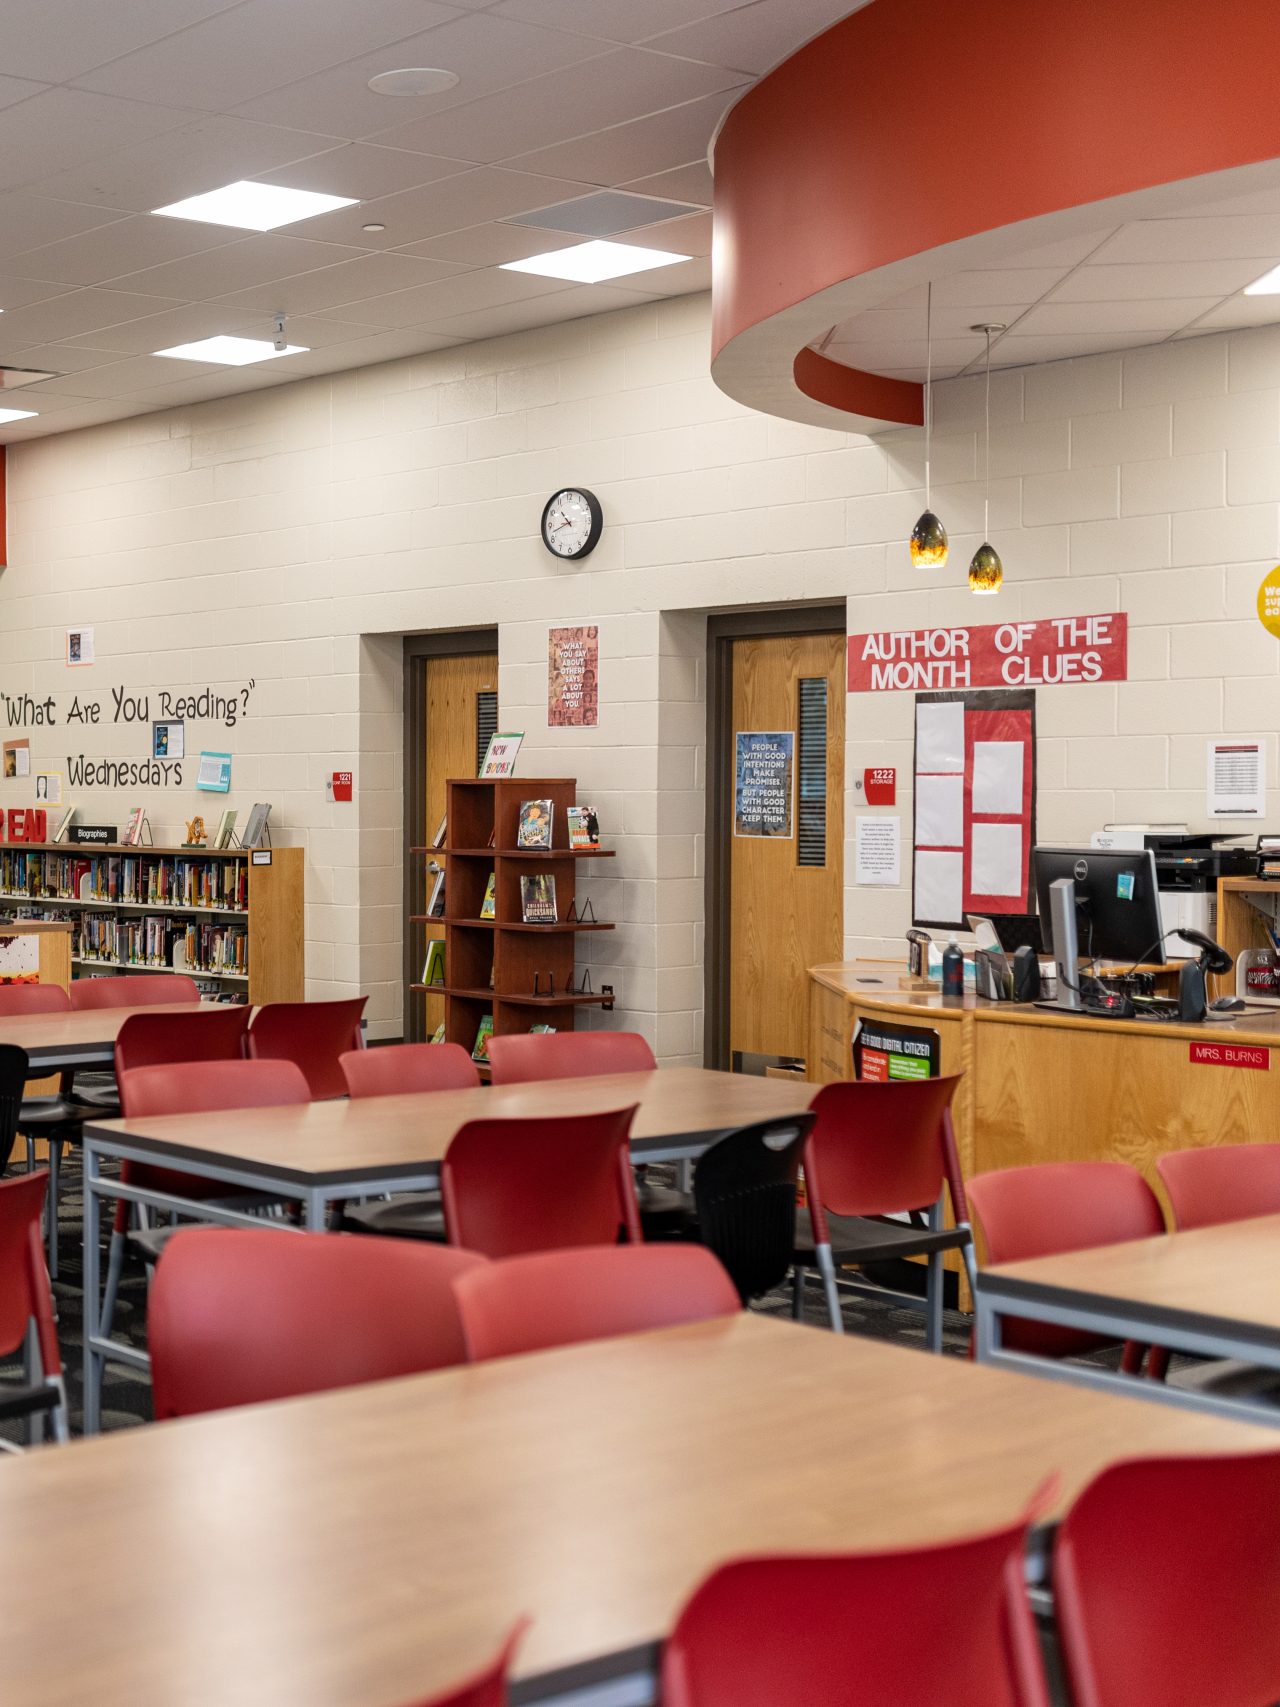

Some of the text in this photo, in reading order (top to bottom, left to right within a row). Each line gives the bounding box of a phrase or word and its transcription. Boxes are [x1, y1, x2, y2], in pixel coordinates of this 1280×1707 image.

[566, 493, 573, 501] 12
[557, 498, 562, 506] 11
[548, 522, 553, 530] 9
[550, 535, 556, 544] 8
[861, 616, 1112, 661] AUTHOR OF THE
[563, 642, 583, 650] WHAT
[575, 650, 587, 658] SAY
[560, 667, 585, 675] OTHERS
[871, 651, 1102, 690] MONTH CLUES
[66, 695, 101, 724] Are
[111, 685, 149, 723] You
[491, 744, 508, 756] NEW
[742, 752, 786, 760] WITH GOOD
[486, 762, 511, 774] BOOKS
[743, 761, 785, 769] INTENTIONS
[66, 753, 183, 788] Wednesdays
[753, 769, 775, 777] MAKE
[872, 769, 894, 779] 1222
[339, 773, 351, 781] 1221
[742, 789, 785, 797] BUT PEOPLE
[742, 798, 785, 806] WITH GOOD
[741, 806, 785, 815] CHARACTER
[763, 815, 785, 823] THEM.
[77, 828, 108, 840] Biographies
[1195, 1047, 1263, 1064] MRS. BURNS
